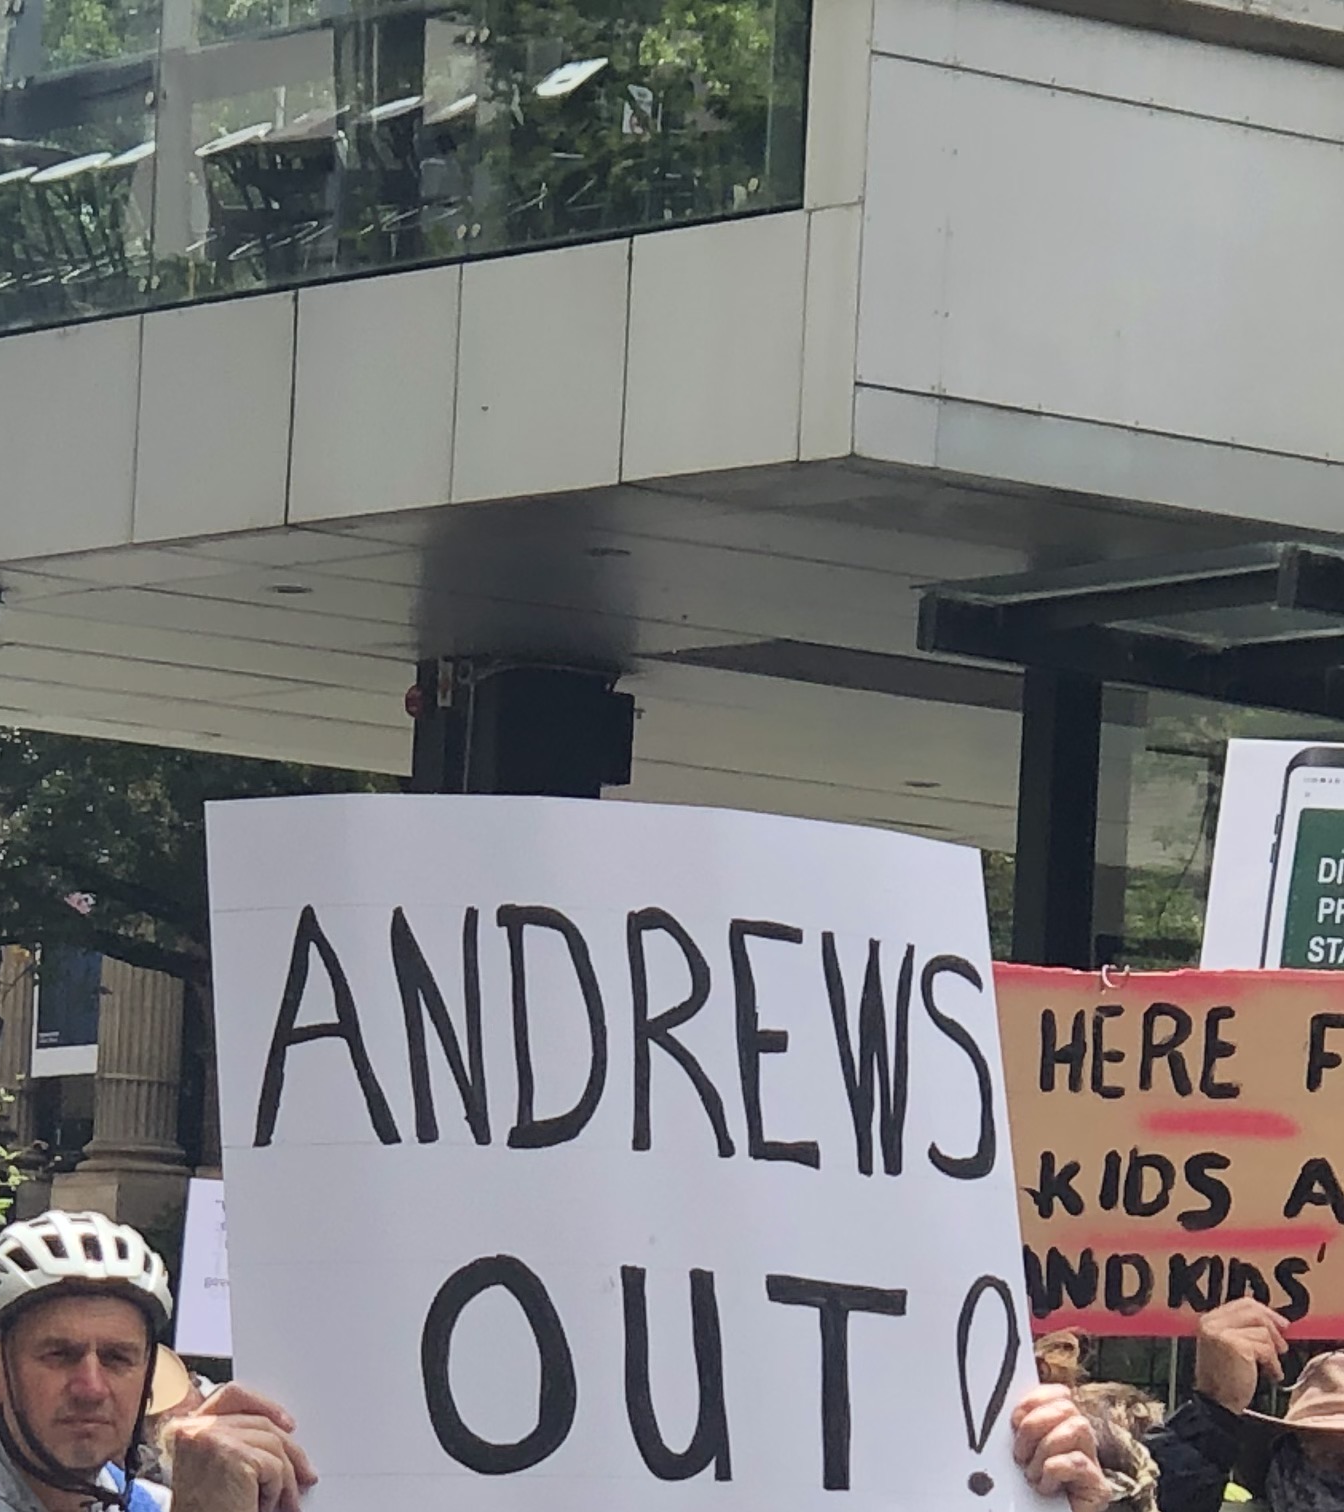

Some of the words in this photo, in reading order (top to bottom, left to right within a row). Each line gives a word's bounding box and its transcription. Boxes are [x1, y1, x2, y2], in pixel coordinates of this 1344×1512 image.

[255, 904, 996, 1179] ANDREWS
[1039, 1002, 1241, 1099] HERE
[1021, 1146, 1233, 1231] KIDS
